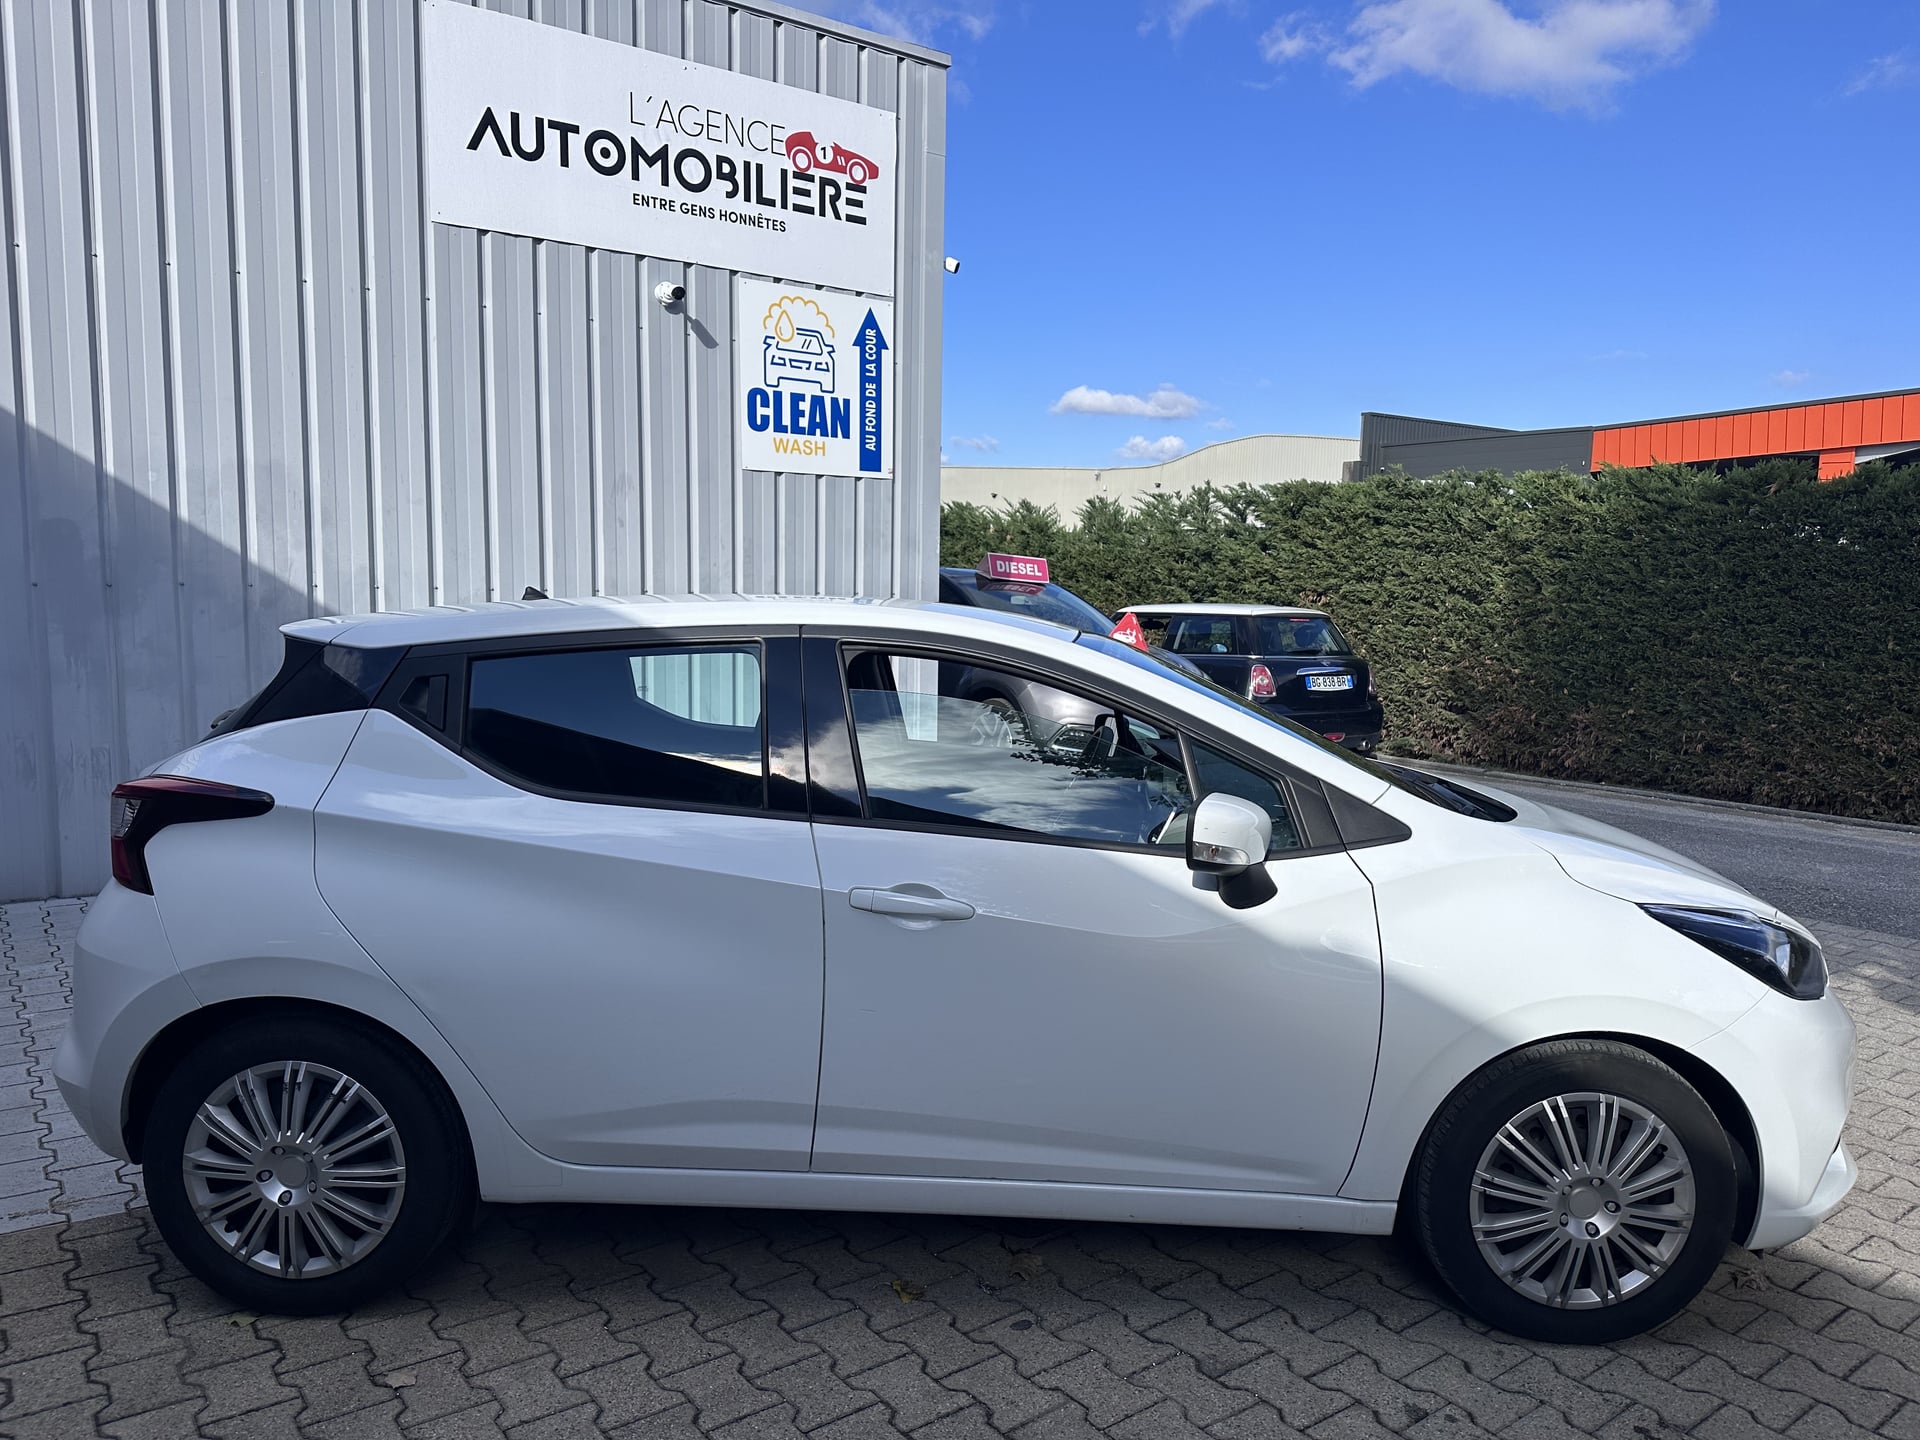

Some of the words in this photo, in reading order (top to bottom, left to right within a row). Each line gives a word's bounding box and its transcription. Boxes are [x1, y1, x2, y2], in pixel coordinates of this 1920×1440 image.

[630, 91, 786, 156] L'AGENCE
[820, 146, 827, 160] 1
[632, 193, 676, 212] ENTRE
[680, 202, 715, 219] GENS
[719, 209, 786, 232] HONNÊTES
[865, 329, 876, 361] COUR
[865, 363, 876, 376] LA
[865, 382, 876, 397] DE
[747, 387, 851, 439] CLEAN
[865, 401, 876, 432] FOND
[773, 437, 826, 456] WASH
[865, 436, 876, 451] AU
[996, 560, 1043, 576] DIESEL
